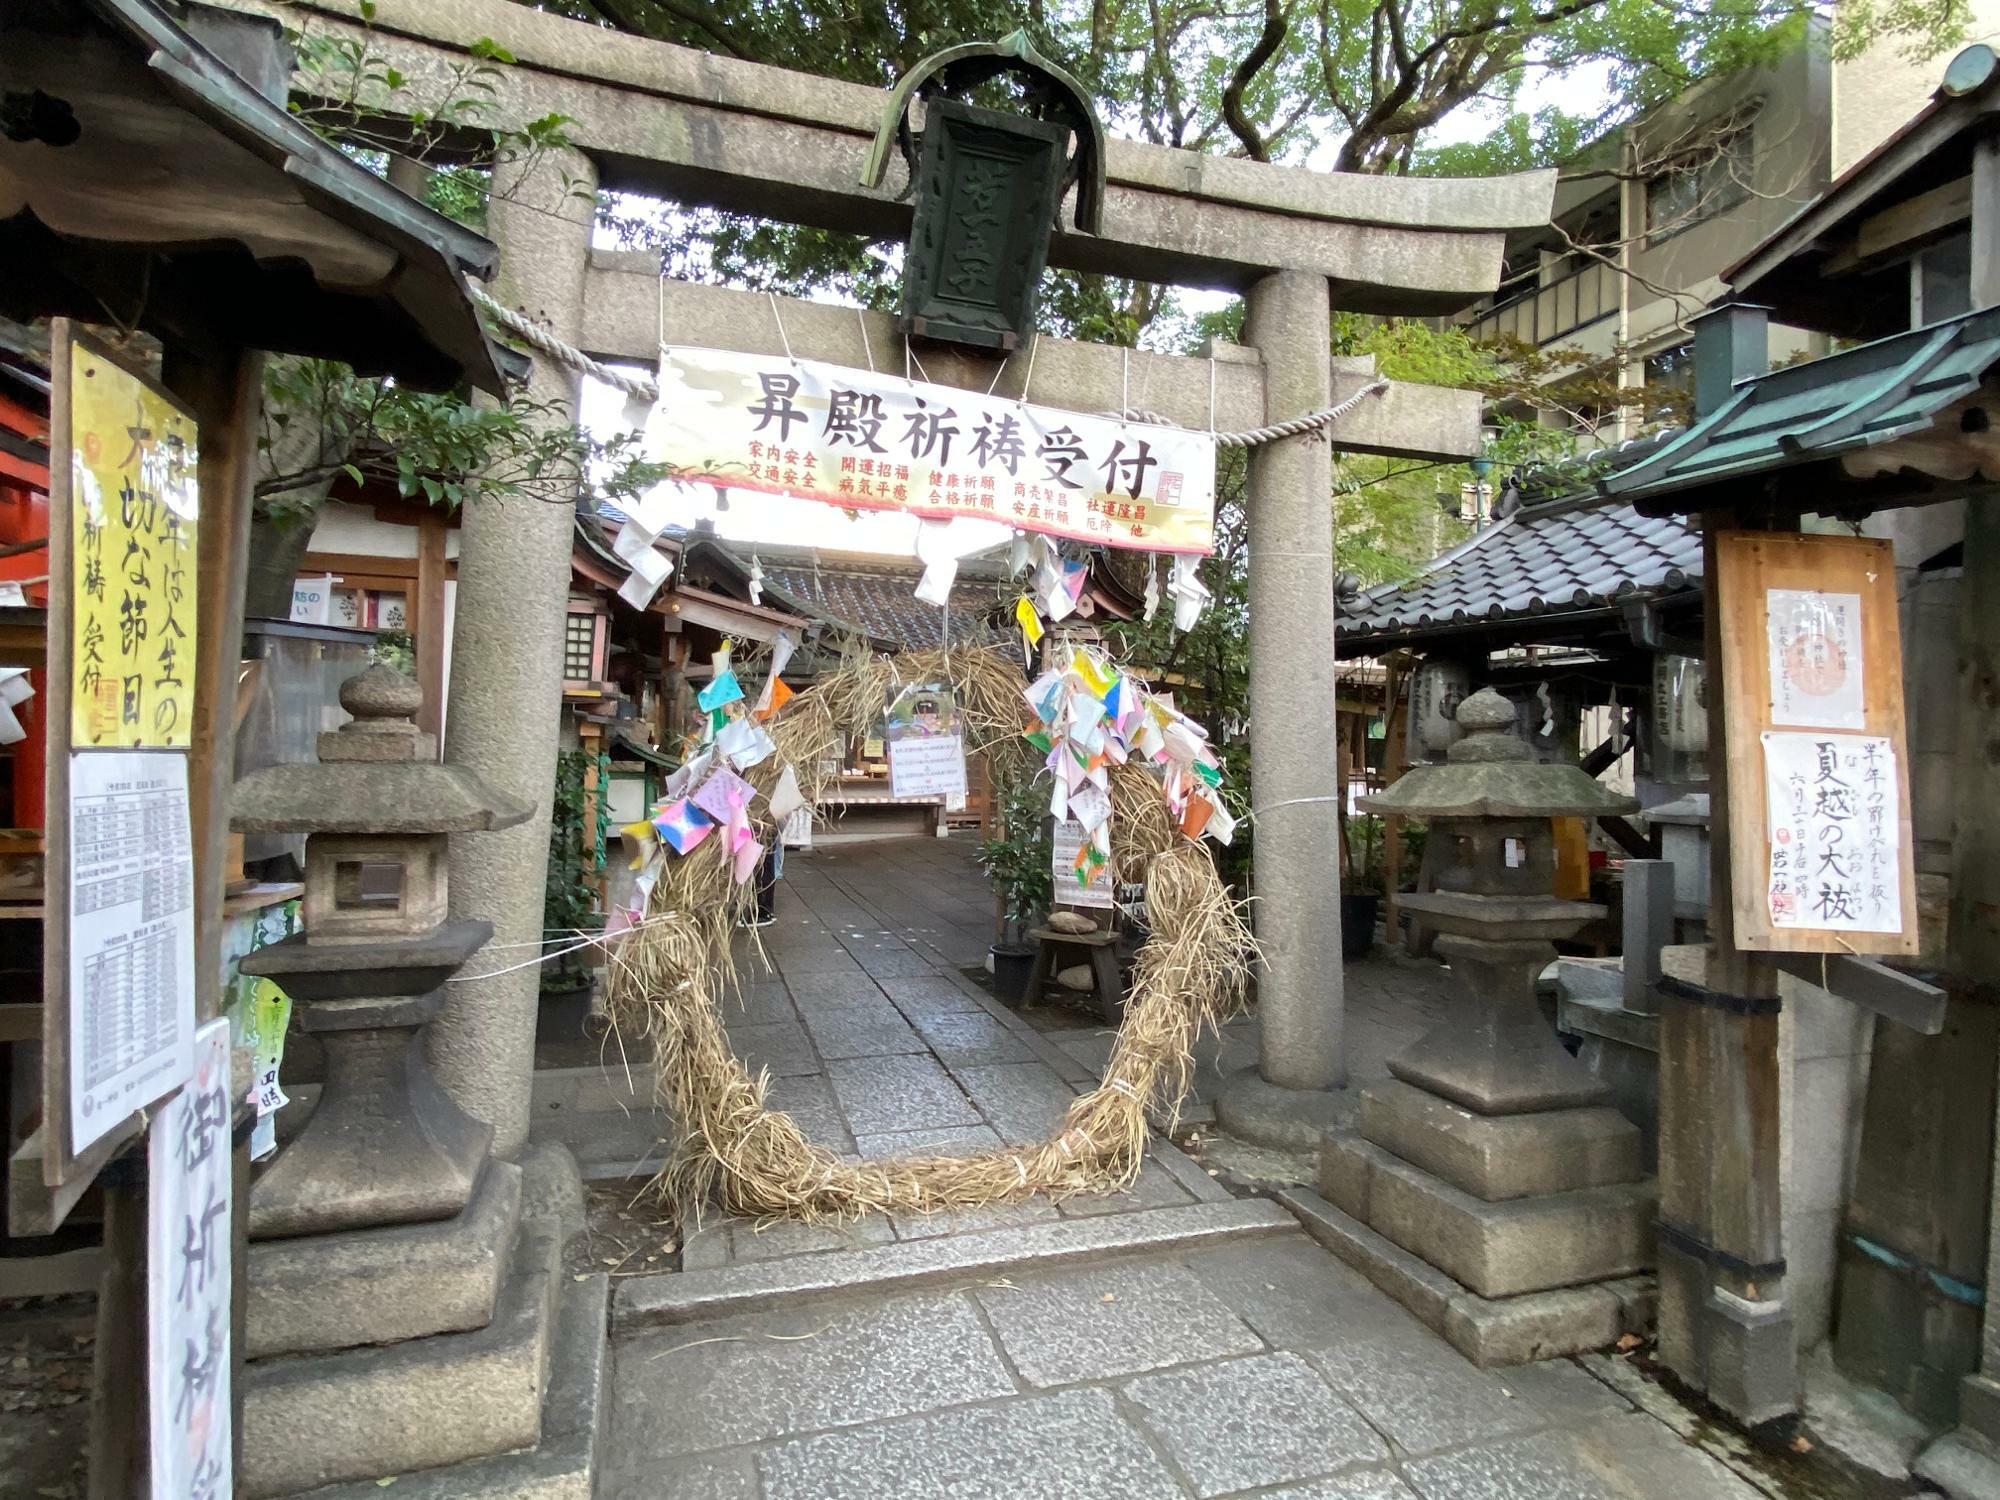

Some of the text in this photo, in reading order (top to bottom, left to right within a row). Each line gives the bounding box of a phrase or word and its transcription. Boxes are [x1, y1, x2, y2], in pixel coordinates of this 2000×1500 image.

[747, 371, 1157, 501] 昇殿祈祷受付
[748, 440, 818, 469] 家内安全
[841, 456, 909, 481] 開運招福
[929, 469, 995, 491] 健康祈願
[1087, 498, 1146, 520] 社運隆昌
[748, 460, 818, 488] 交通安全
[839, 477, 908, 501] 病気平癒
[929, 489, 994, 510] 合格祈願
[1012, 500, 1069, 525] 安産祈願
[1130, 523, 1143, 537] 他
[118, 401, 157, 726] 大切な節目
[1813, 742, 1856, 921] 夏越の大祓
